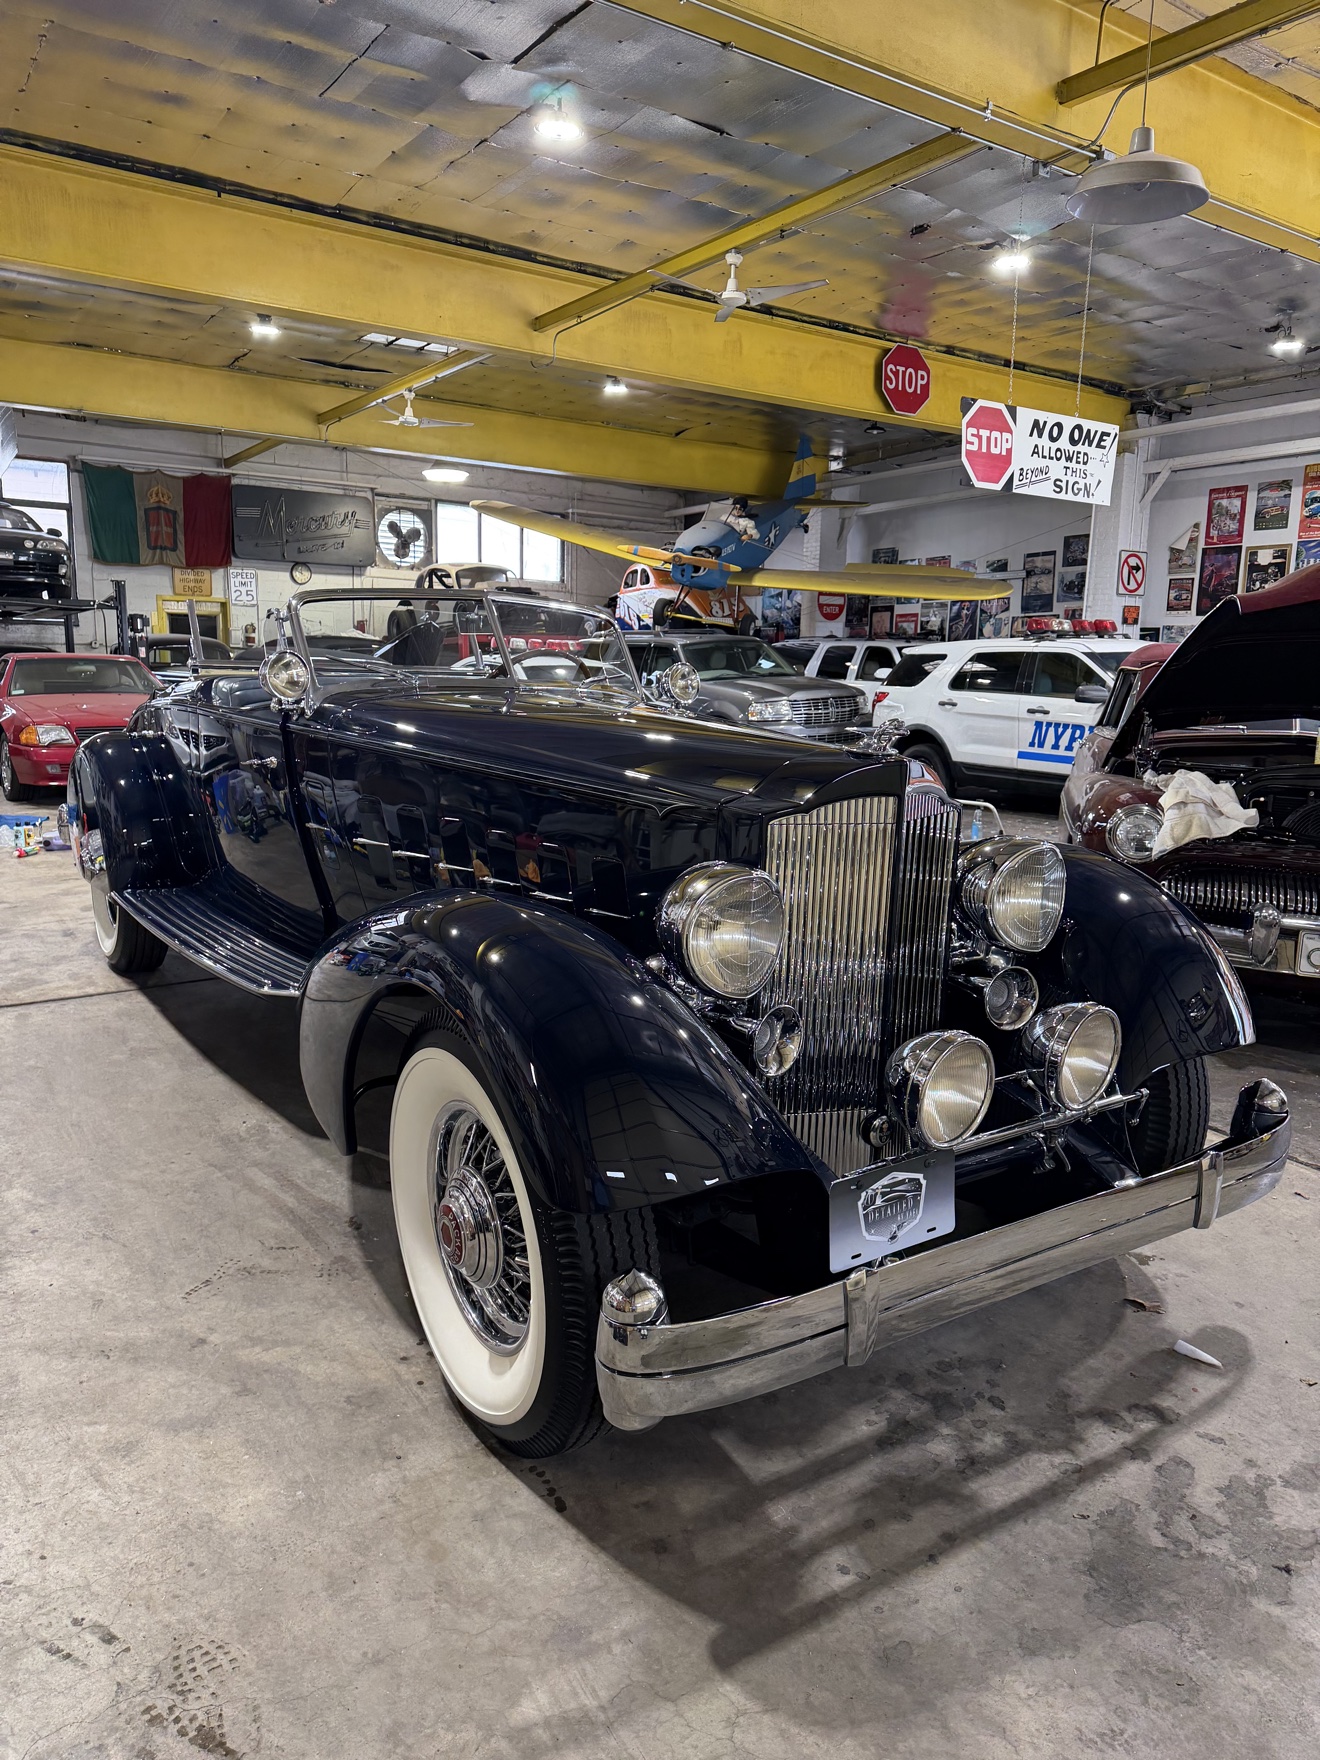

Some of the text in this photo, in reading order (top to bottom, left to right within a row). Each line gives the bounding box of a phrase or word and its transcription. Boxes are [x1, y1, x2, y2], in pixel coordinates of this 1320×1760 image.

[886, 363, 928, 395] STOP
[966, 427, 1013, 456] STOP
[1028, 418, 1064, 443] NO
[1017, 465, 1051, 488] BEYOND
[1063, 466, 1089, 480] THIS
[1052, 477, 1103, 499] SIGN!
[257, 494, 357, 559] Mercury
[231, 572, 255, 580] SPEED
[233, 580, 253, 588] LIMIT
[182, 585, 204, 593] ENDS
[233, 589, 255, 602] 25
[823, 605, 839, 614] ENTER
[1028, 720, 1096, 752] NYP
[868, 1197, 914, 1223] DETAILED
[448, 1211, 461, 1264] PACKARD
